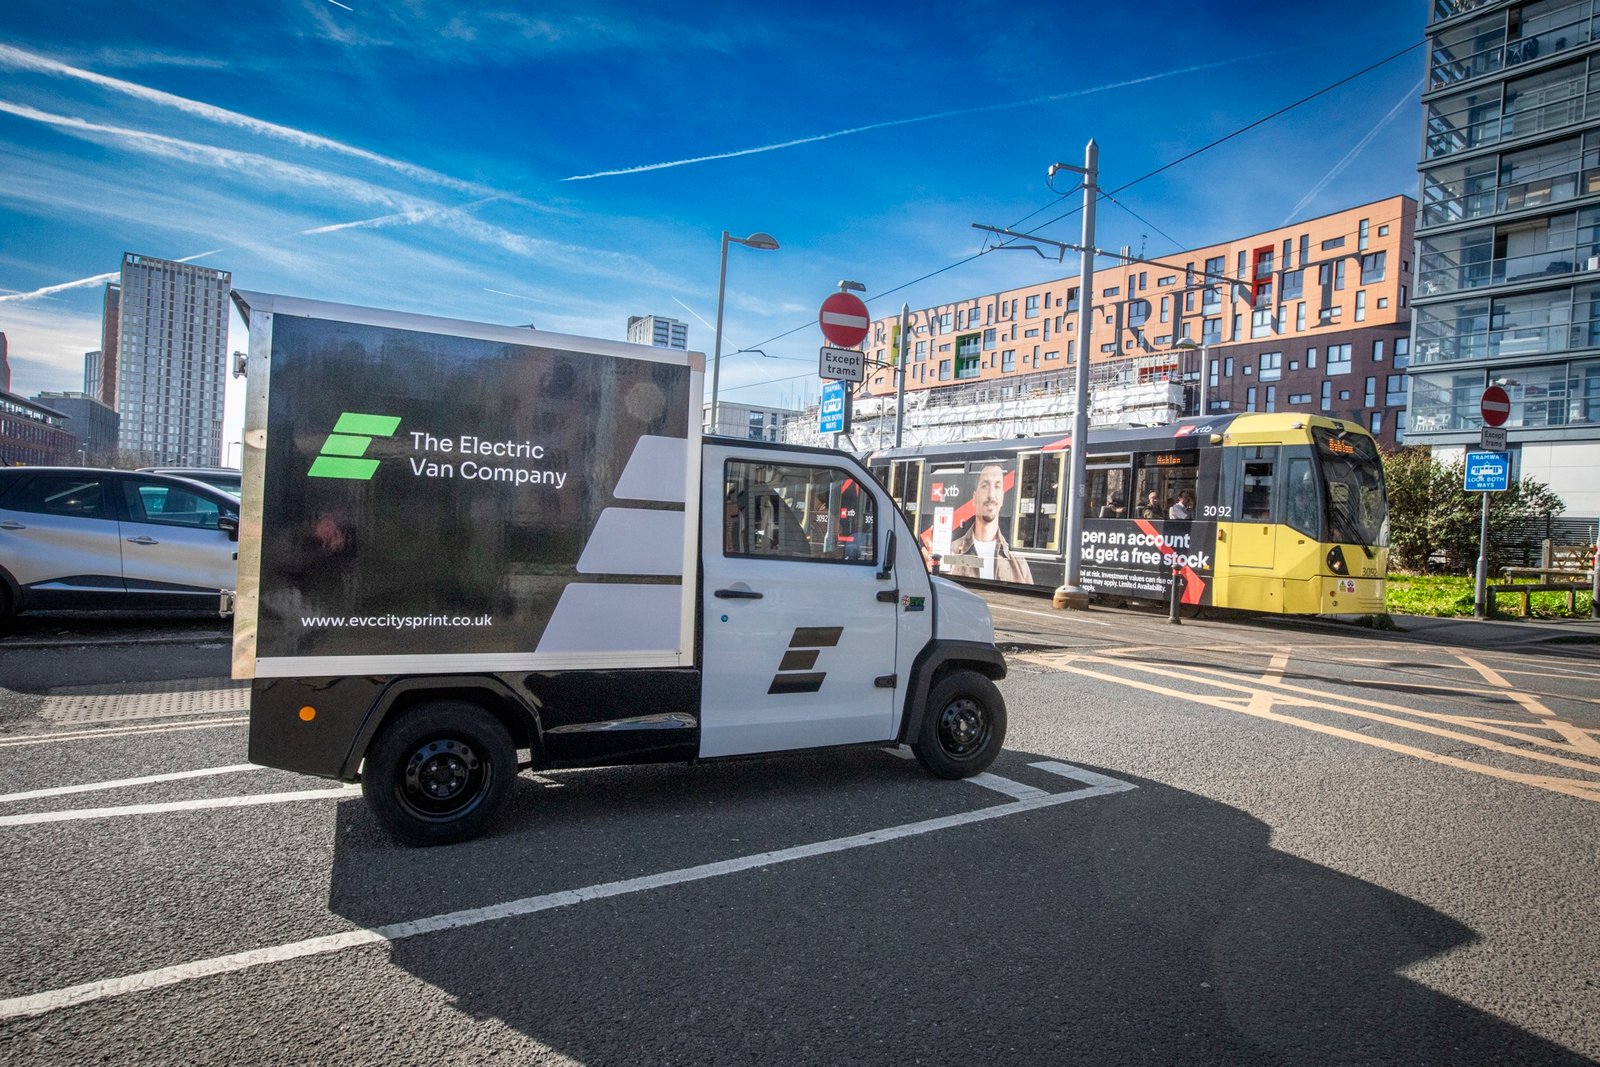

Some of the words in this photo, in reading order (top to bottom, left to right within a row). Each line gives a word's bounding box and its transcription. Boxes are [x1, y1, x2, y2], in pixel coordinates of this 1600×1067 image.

[896, 293, 1013, 341] RWELL
[825, 352, 860, 366] Except
[827, 364, 856, 376] trams
[826, 421, 837, 429] WAYS
[1192, 425, 1212, 434] xtb
[1484, 430, 1505, 440] Except
[409, 431, 453, 453] The
[460, 435, 544, 459] Electric
[1485, 439, 1503, 448] trams
[409, 457, 454, 478] Van
[460, 461, 567, 489] Company
[944, 484, 960, 497] xtb
[816, 514, 828, 522] 3092
[1081, 530, 1106, 546] pen
[1108, 532, 1126, 545] an
[1127, 533, 1191, 549] account
[1095, 547, 1119, 563] get
[1120, 550, 1129, 562] a
[1131, 547, 1161, 563] free
[1163, 551, 1211, 570] stock.
[1101, 571, 1128, 581] Investment
[1128, 573, 1145, 582] values
[1362, 567, 1378, 577] 3092
[1093, 578, 1103, 587] may
[1103, 579, 1119, 589] apply.
[1118, 580, 1137, 589] Limited
[1137, 582, 1167, 594] Availability.
[301, 613, 492, 630] www.evccitysprint.co.uk
